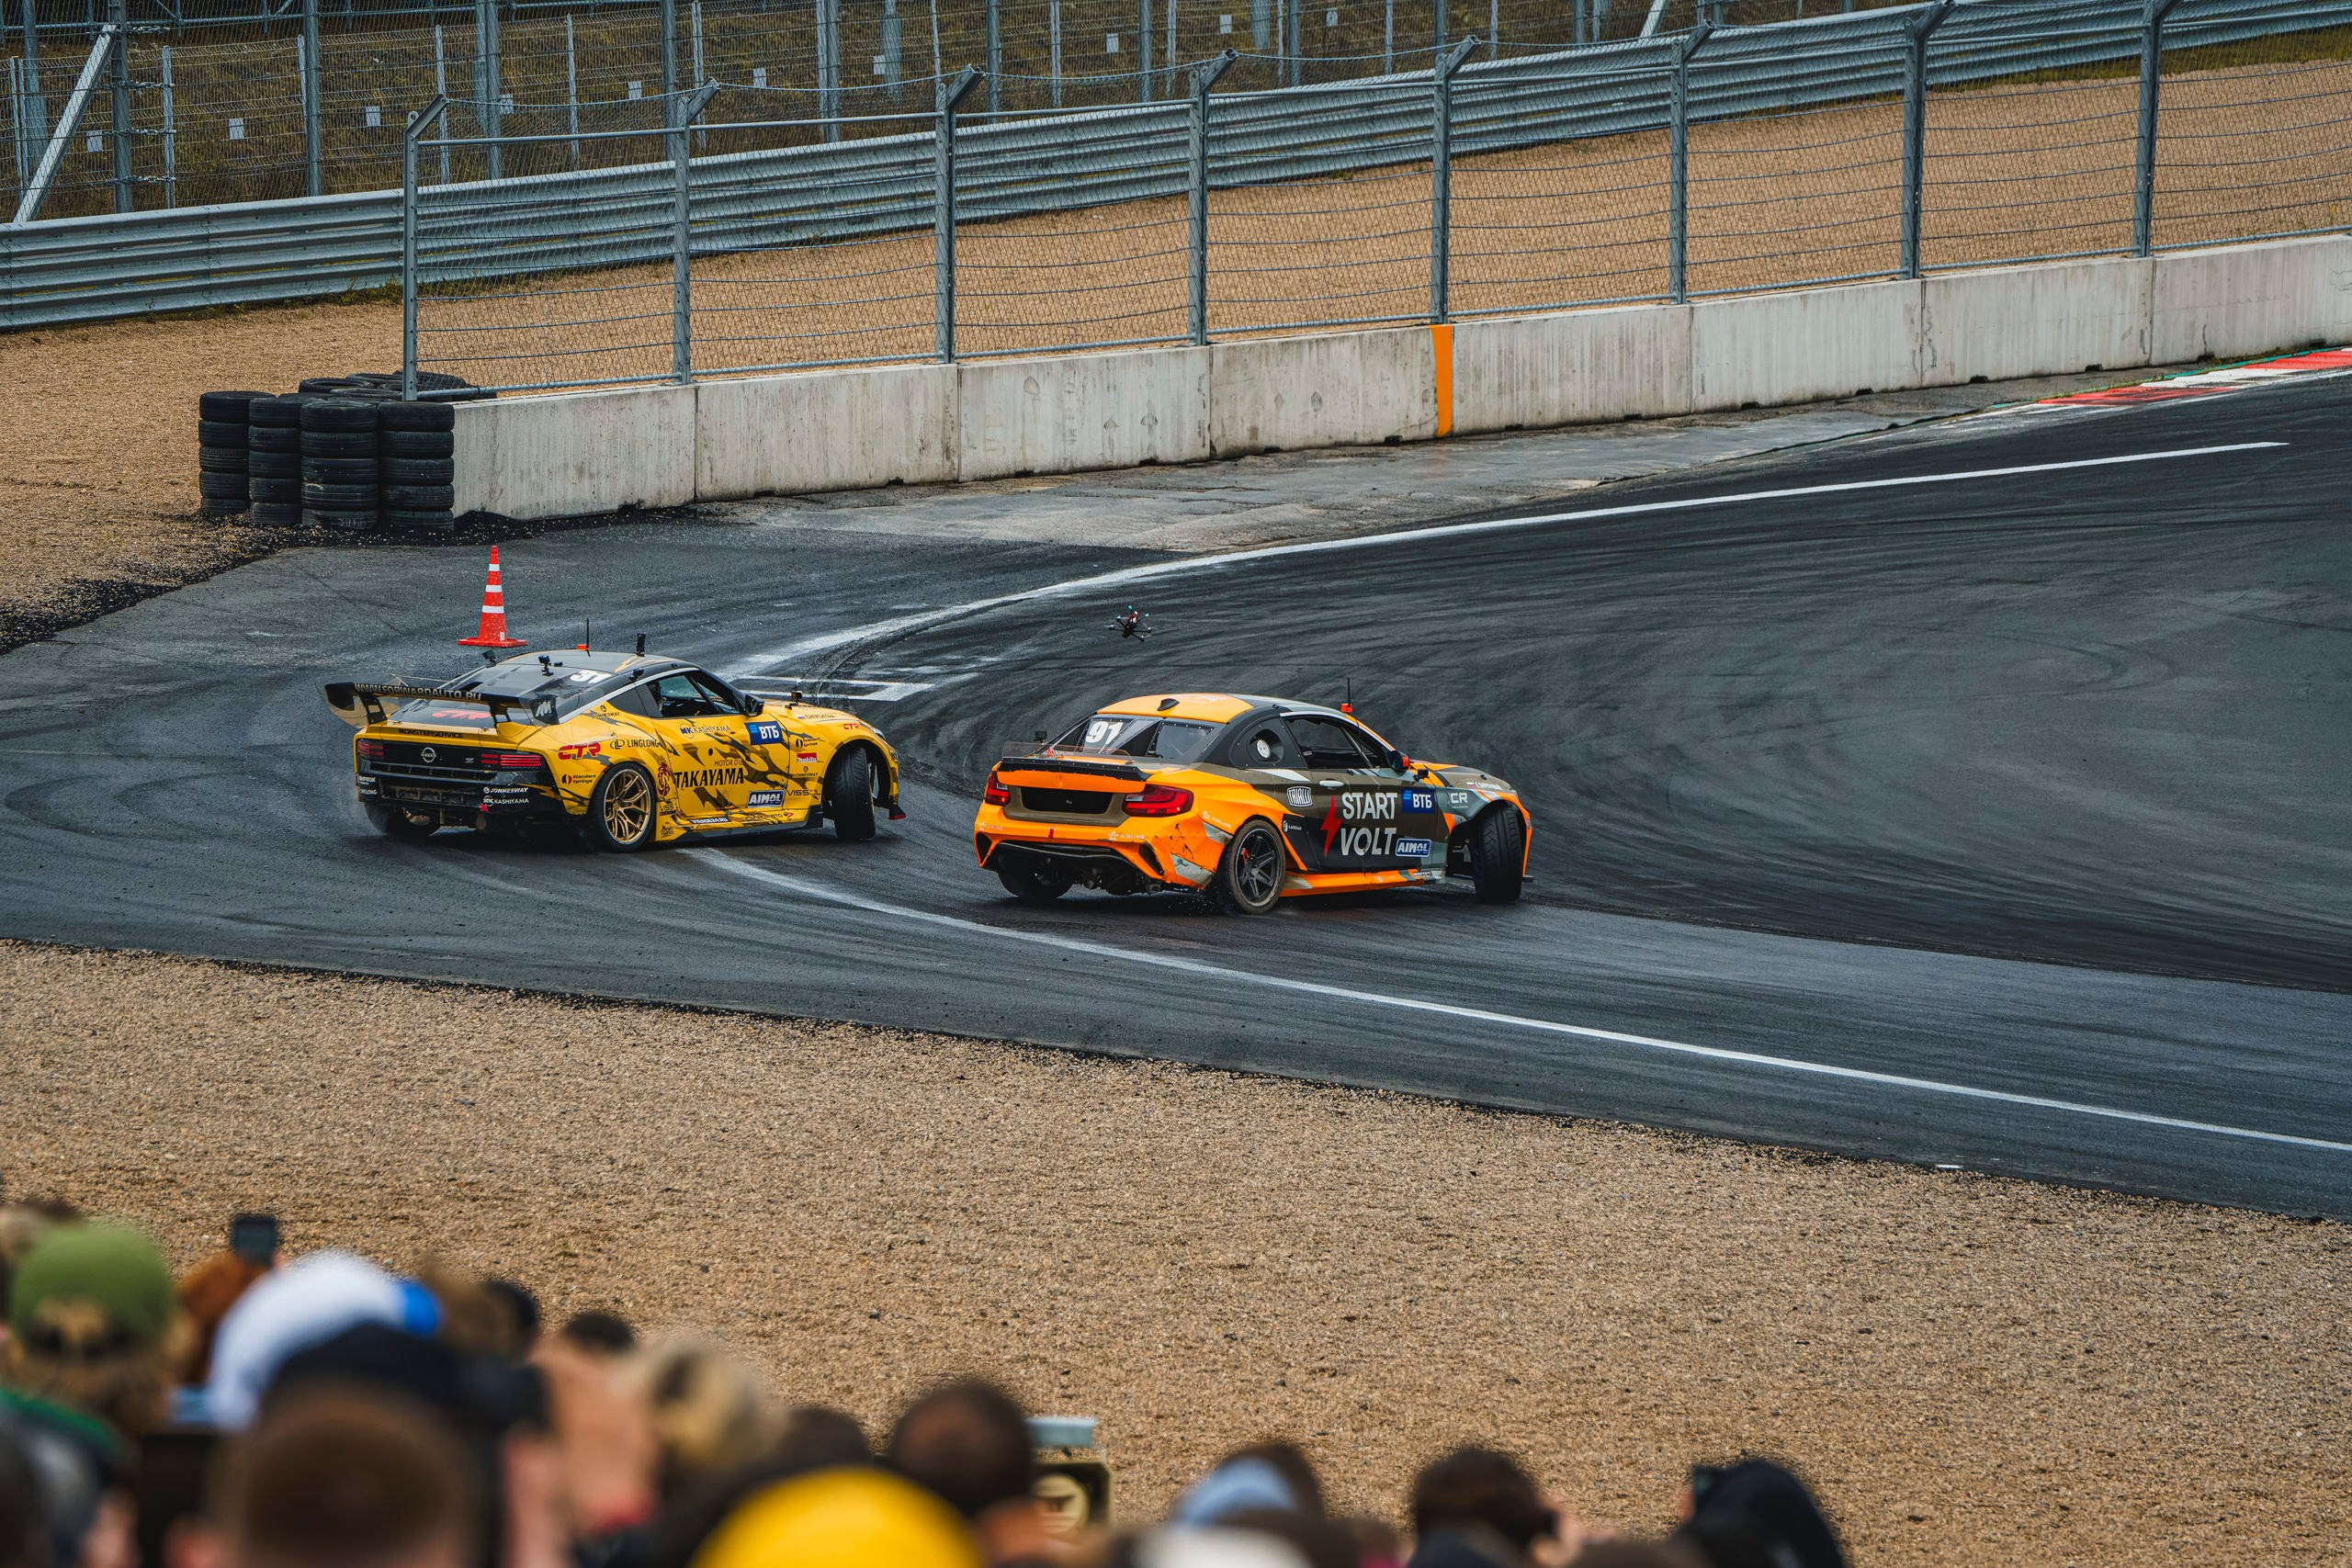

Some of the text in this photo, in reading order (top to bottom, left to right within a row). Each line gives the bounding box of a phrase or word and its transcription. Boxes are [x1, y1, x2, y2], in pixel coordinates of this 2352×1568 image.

[694, 725, 731, 734] KASHIYAMA
[759, 725, 780, 739] ВТБ
[1086, 721, 1124, 744] 91
[628, 739, 661, 748] LINGLONG
[558, 742, 601, 761] CTR
[673, 768, 744, 788] TAKAYAMA
[750, 794, 781, 805] AIMOL
[1341, 792, 1397, 819] START
[1412, 794, 1432, 809] ВТБ
[1451, 793, 1467, 804] CR
[1340, 828, 1397, 856] VOLT
[1397, 842, 1429, 852] AIMOL
